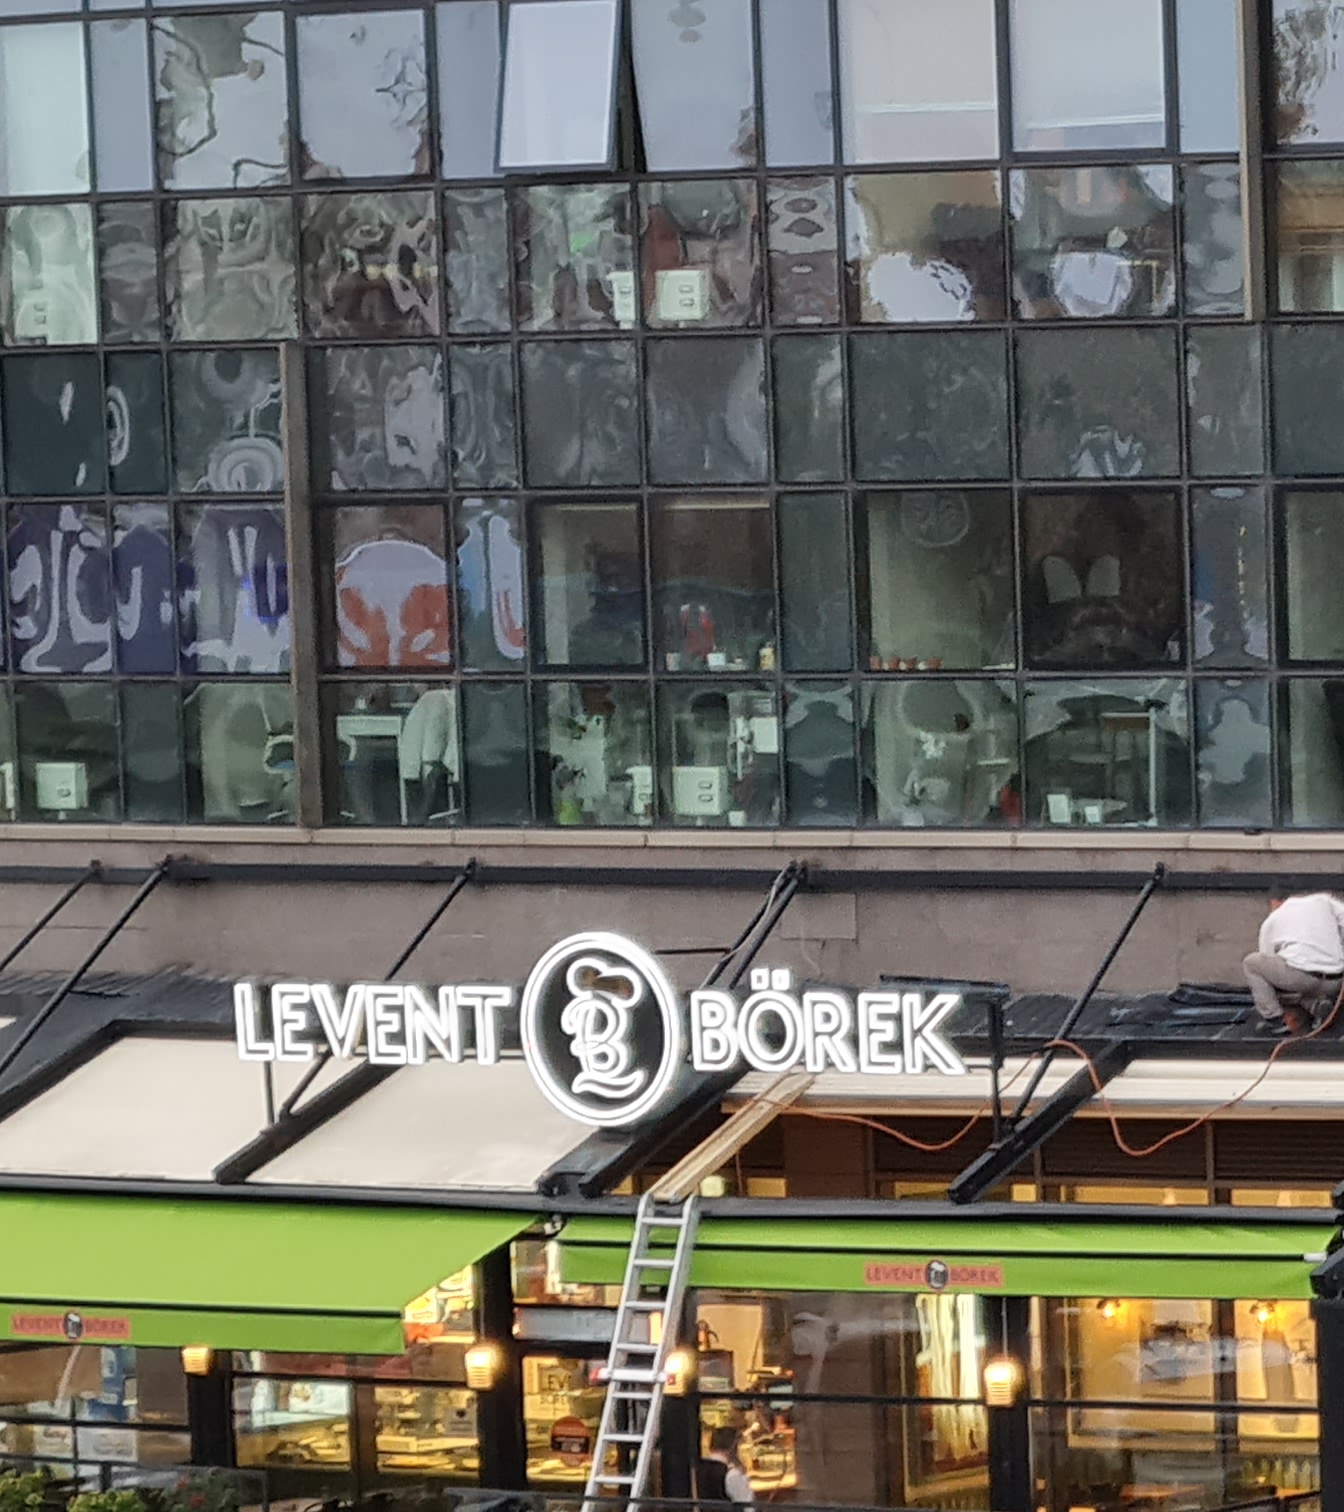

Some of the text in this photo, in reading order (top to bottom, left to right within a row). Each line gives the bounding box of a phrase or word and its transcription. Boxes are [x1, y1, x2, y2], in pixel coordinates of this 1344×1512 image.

[234, 982, 514, 1066] LEVENT
[690, 967, 968, 1076] BÖREK
[866, 1266, 922, 1283] LEVENT
